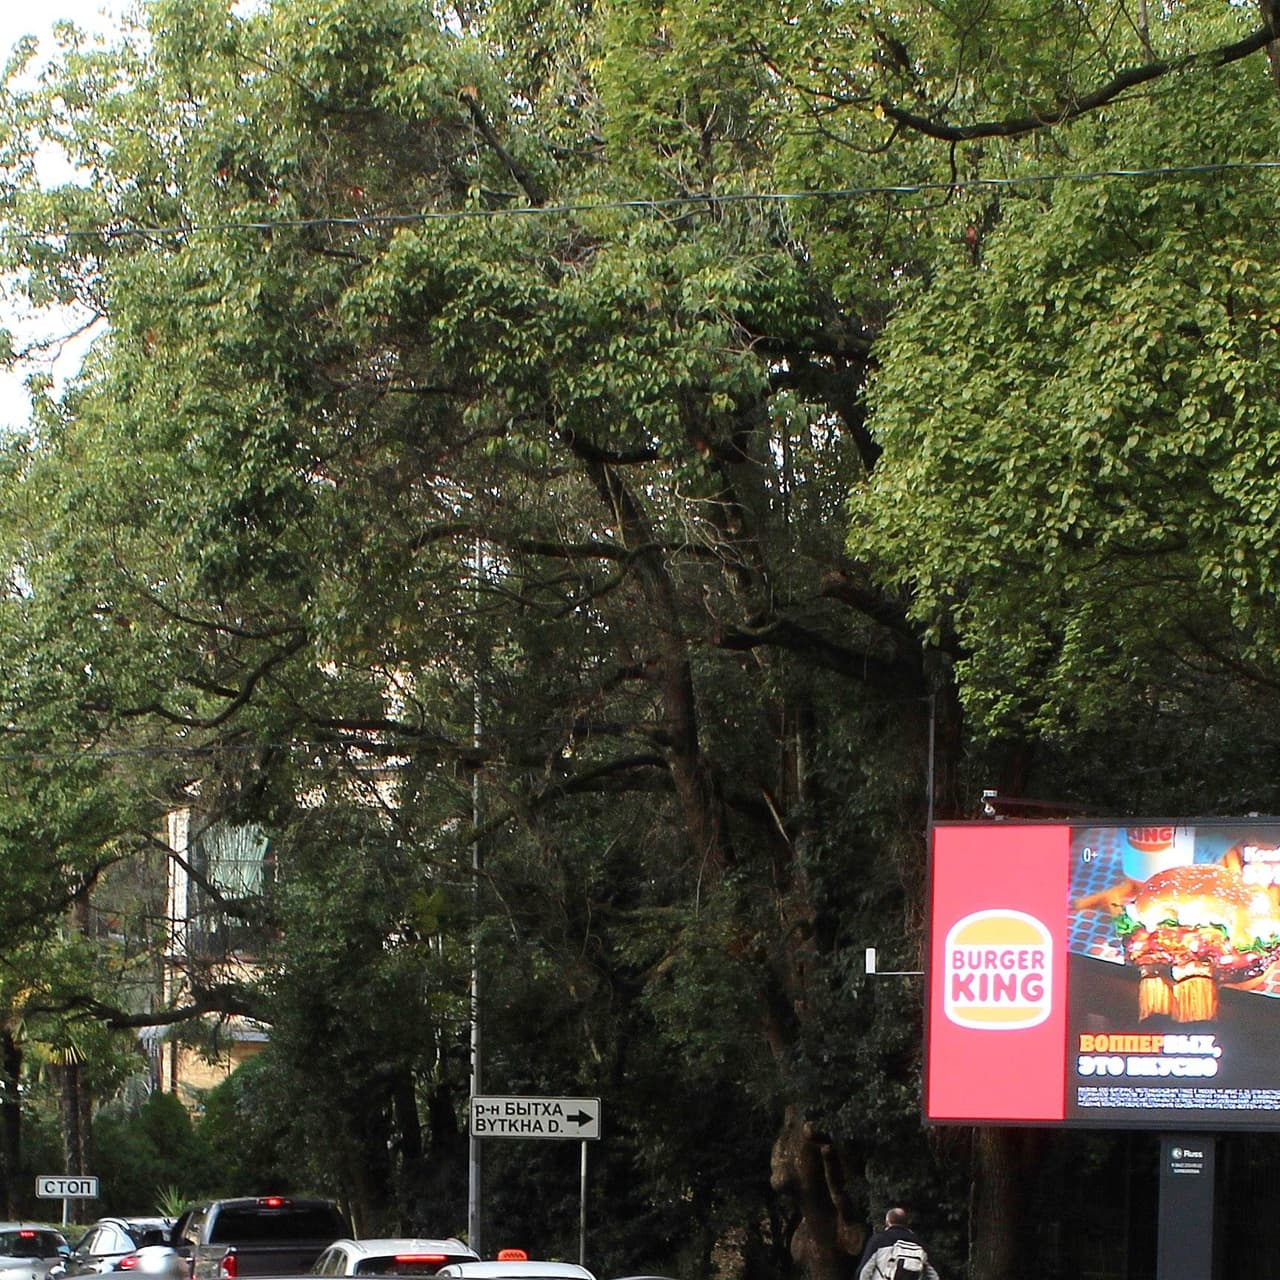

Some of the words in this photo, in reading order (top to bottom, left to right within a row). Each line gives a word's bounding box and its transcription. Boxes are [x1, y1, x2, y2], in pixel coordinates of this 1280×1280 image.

[1083, 848, 1098, 862] 0+
[952, 950, 1044, 970] BURGER
[952, 973, 1044, 1002] KING
[1078, 1056, 1124, 1075] ЭТО
[1127, 1057, 1218, 1076] ВКУСНО
[475, 1104, 499, 1117] р-н
[505, 1103, 563, 1116] БЫТХА
[475, 1119, 543, 1132] BYTKHA
[548, 1120, 564, 1133] D.
[45, 1181, 90, 1194] СТОП
